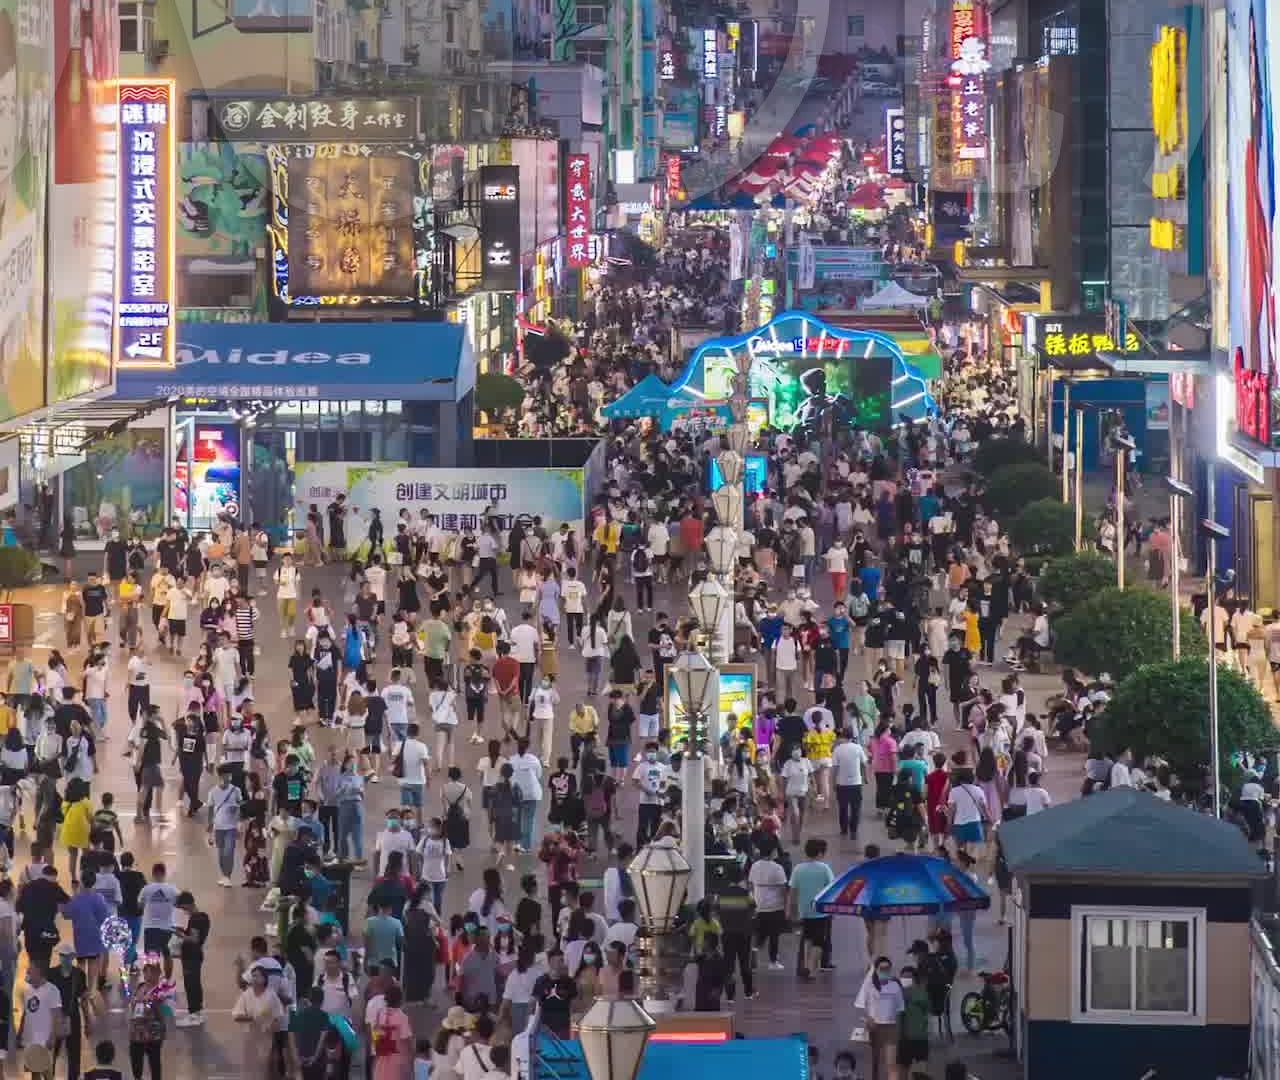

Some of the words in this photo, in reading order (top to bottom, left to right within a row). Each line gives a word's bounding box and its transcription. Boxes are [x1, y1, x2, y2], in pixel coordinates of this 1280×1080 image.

[395, 482, 508, 502] 创建文明城市
